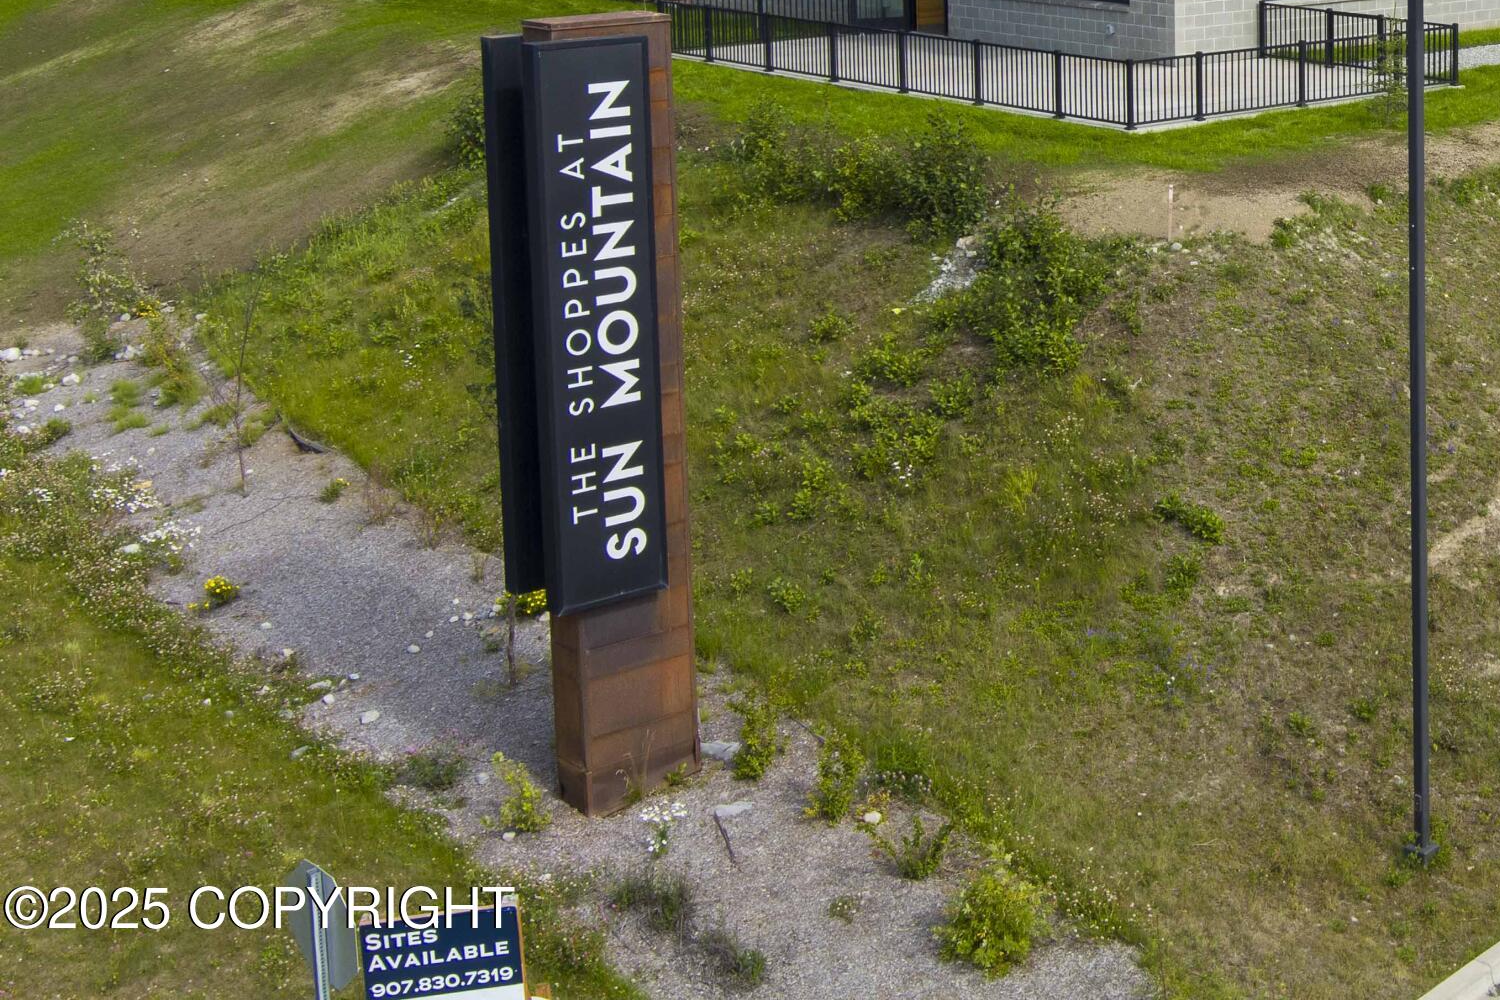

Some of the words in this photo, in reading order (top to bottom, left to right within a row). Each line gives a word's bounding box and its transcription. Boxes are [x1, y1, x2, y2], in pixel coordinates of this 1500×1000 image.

[557, 133, 585, 180] AT
[587, 78, 643, 409] MOUNTAIN
[560, 214, 595, 417] SHOPPES
[571, 441, 600, 525] THE
[601, 438, 648, 560] SUN
[364, 929, 439, 951] SITES
[368, 940, 510, 972] AVAILABLE
[371, 966, 514, 998] 907.830.7319
